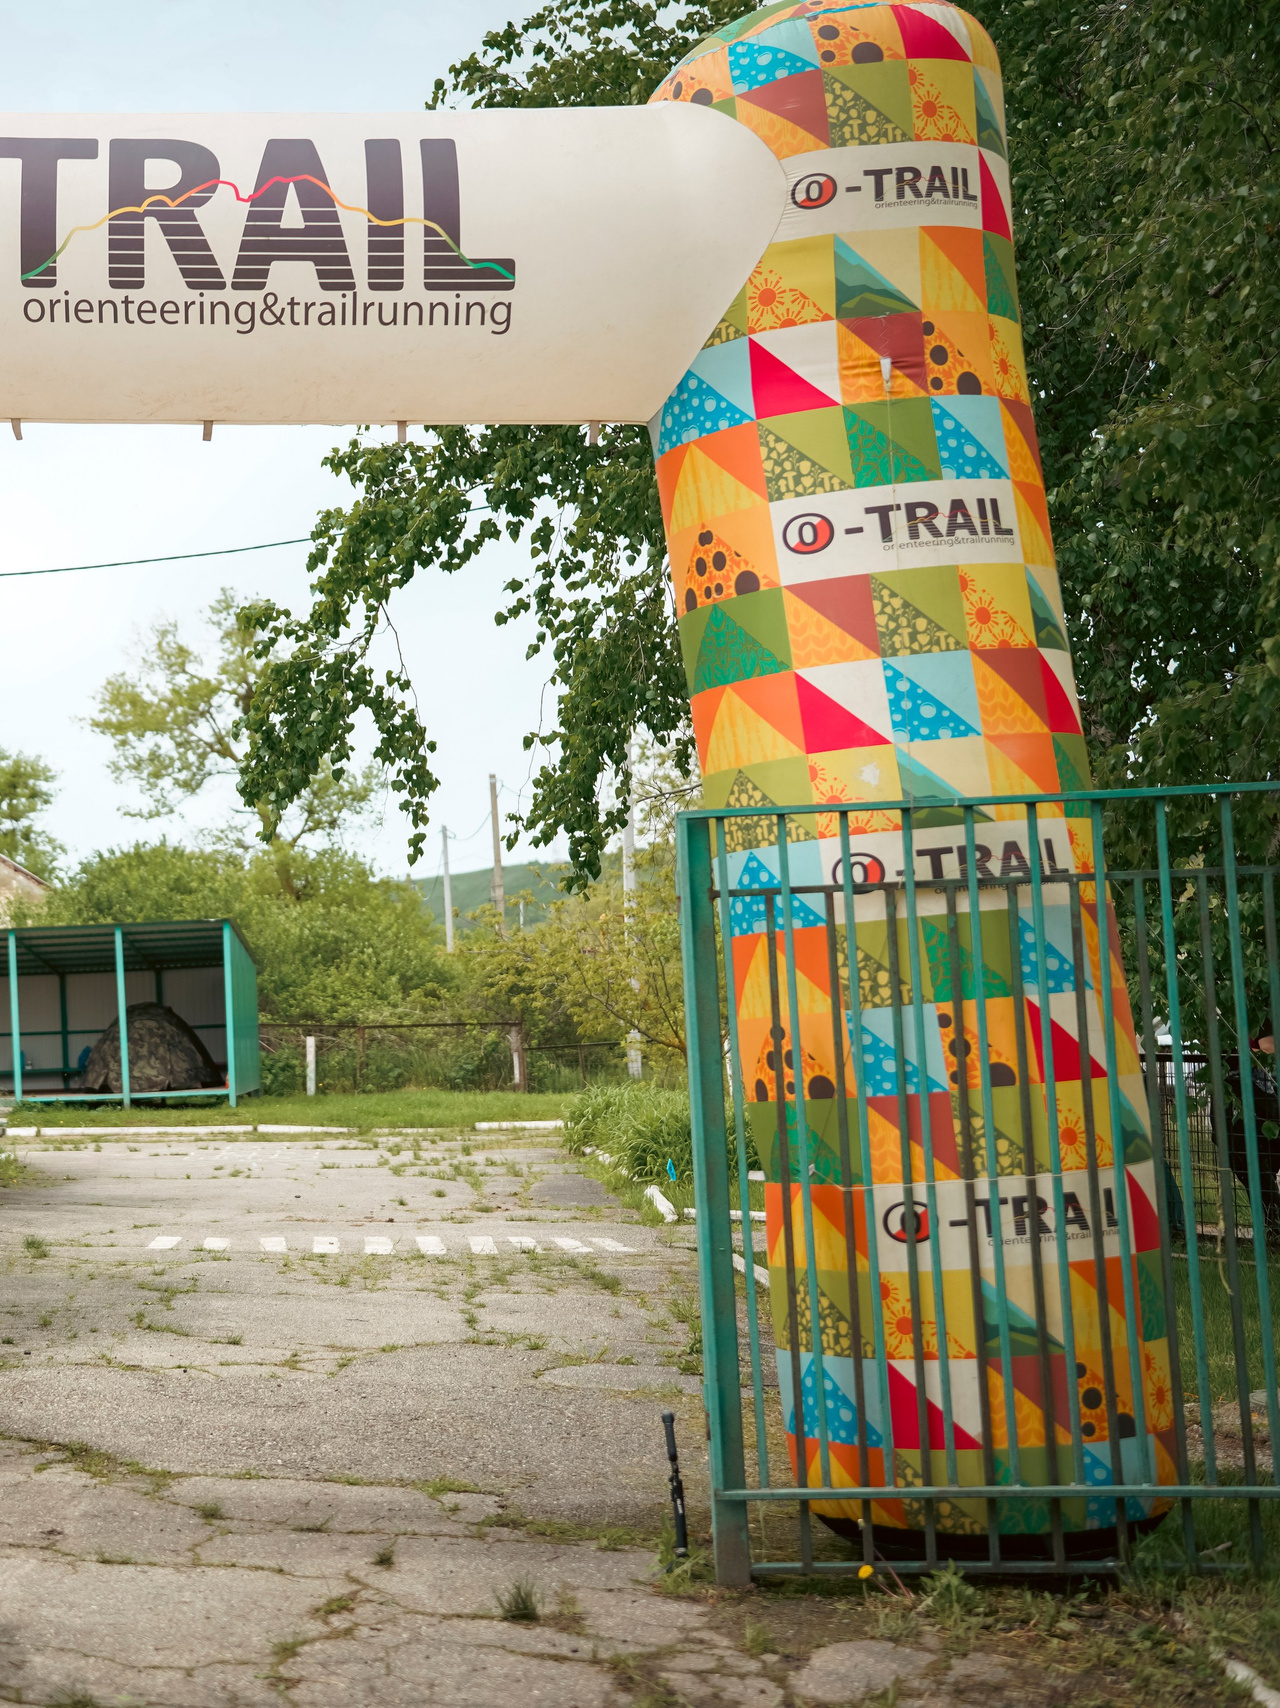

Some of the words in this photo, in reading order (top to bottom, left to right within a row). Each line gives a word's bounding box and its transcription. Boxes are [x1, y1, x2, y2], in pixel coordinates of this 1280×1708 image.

[874, 197, 978, 210] orienteering&trailrunning
[22, 292, 513, 335] orienteering&trailrunning
[883, 535, 1015, 551] orenteering&trailrunning
